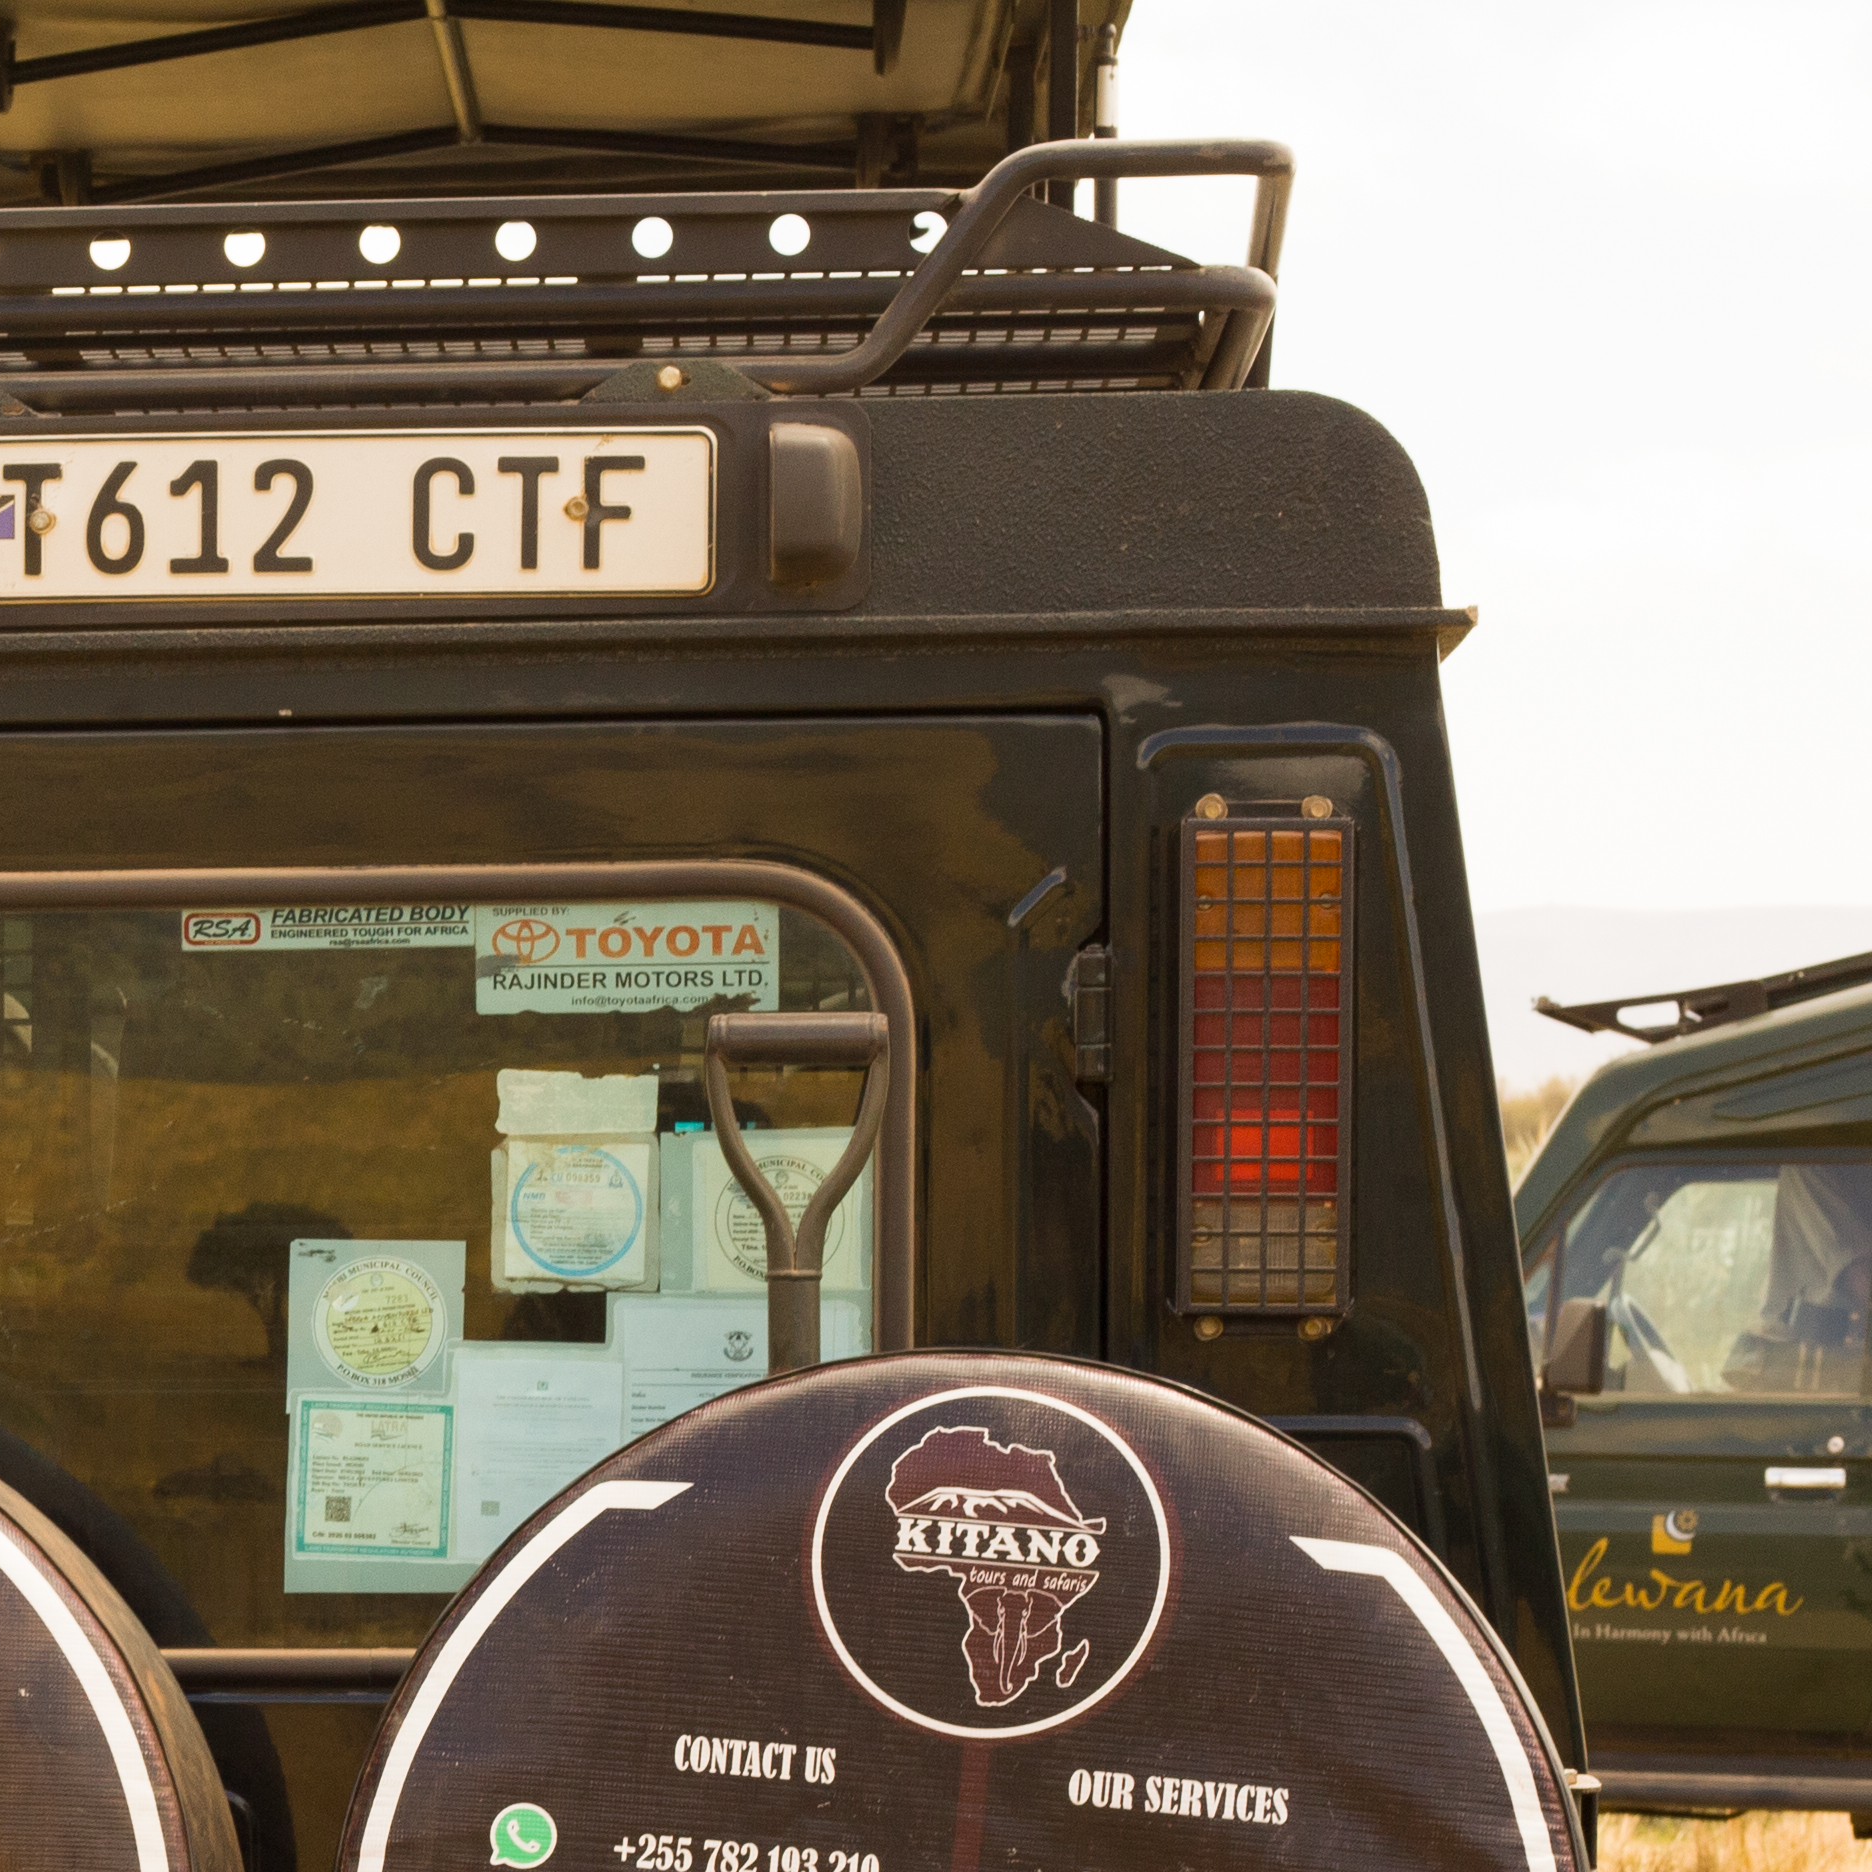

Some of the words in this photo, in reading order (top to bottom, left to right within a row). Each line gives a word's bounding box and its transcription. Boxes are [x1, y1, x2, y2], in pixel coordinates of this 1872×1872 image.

[2, 459, 315, 576] T612
[412, 455, 646, 572] CTF
[271, 907, 404, 924] FABRICATED
[409, 905, 471, 921] BODY
[492, 907, 548, 917] SUPPLIED
[192, 919, 253, 939] RSA
[271, 927, 349, 939] ENGINEERED
[352, 927, 394, 938] TOUGH
[397, 926, 422, 937] FOR
[425, 925, 469, 937] AFRICA
[565, 924, 766, 960] TOYOTA
[493, 971, 607, 991] RAJINDER
[615, 970, 714, 989] MOTORS
[723, 969, 769, 988] LTD.
[348, 1261, 401, 1276] MUNICIPAL
[895, 1518, 1101, 1567] KITANO
[970, 1567, 1006, 1585] tours
[1012, 1571, 1037, 1589] and
[1043, 1573, 1088, 1592] safaris
[1595, 1623, 1672, 1645] Harmony
[1675, 1626, 1712, 1642] with
[674, 1734, 797, 1781] CONTACT
[803, 1747, 837, 1785] US
[1068, 1768, 1135, 1810] OUR
[1144, 1775, 1289, 1825] SERVICES
[613, 1833, 693, 1872] +255
